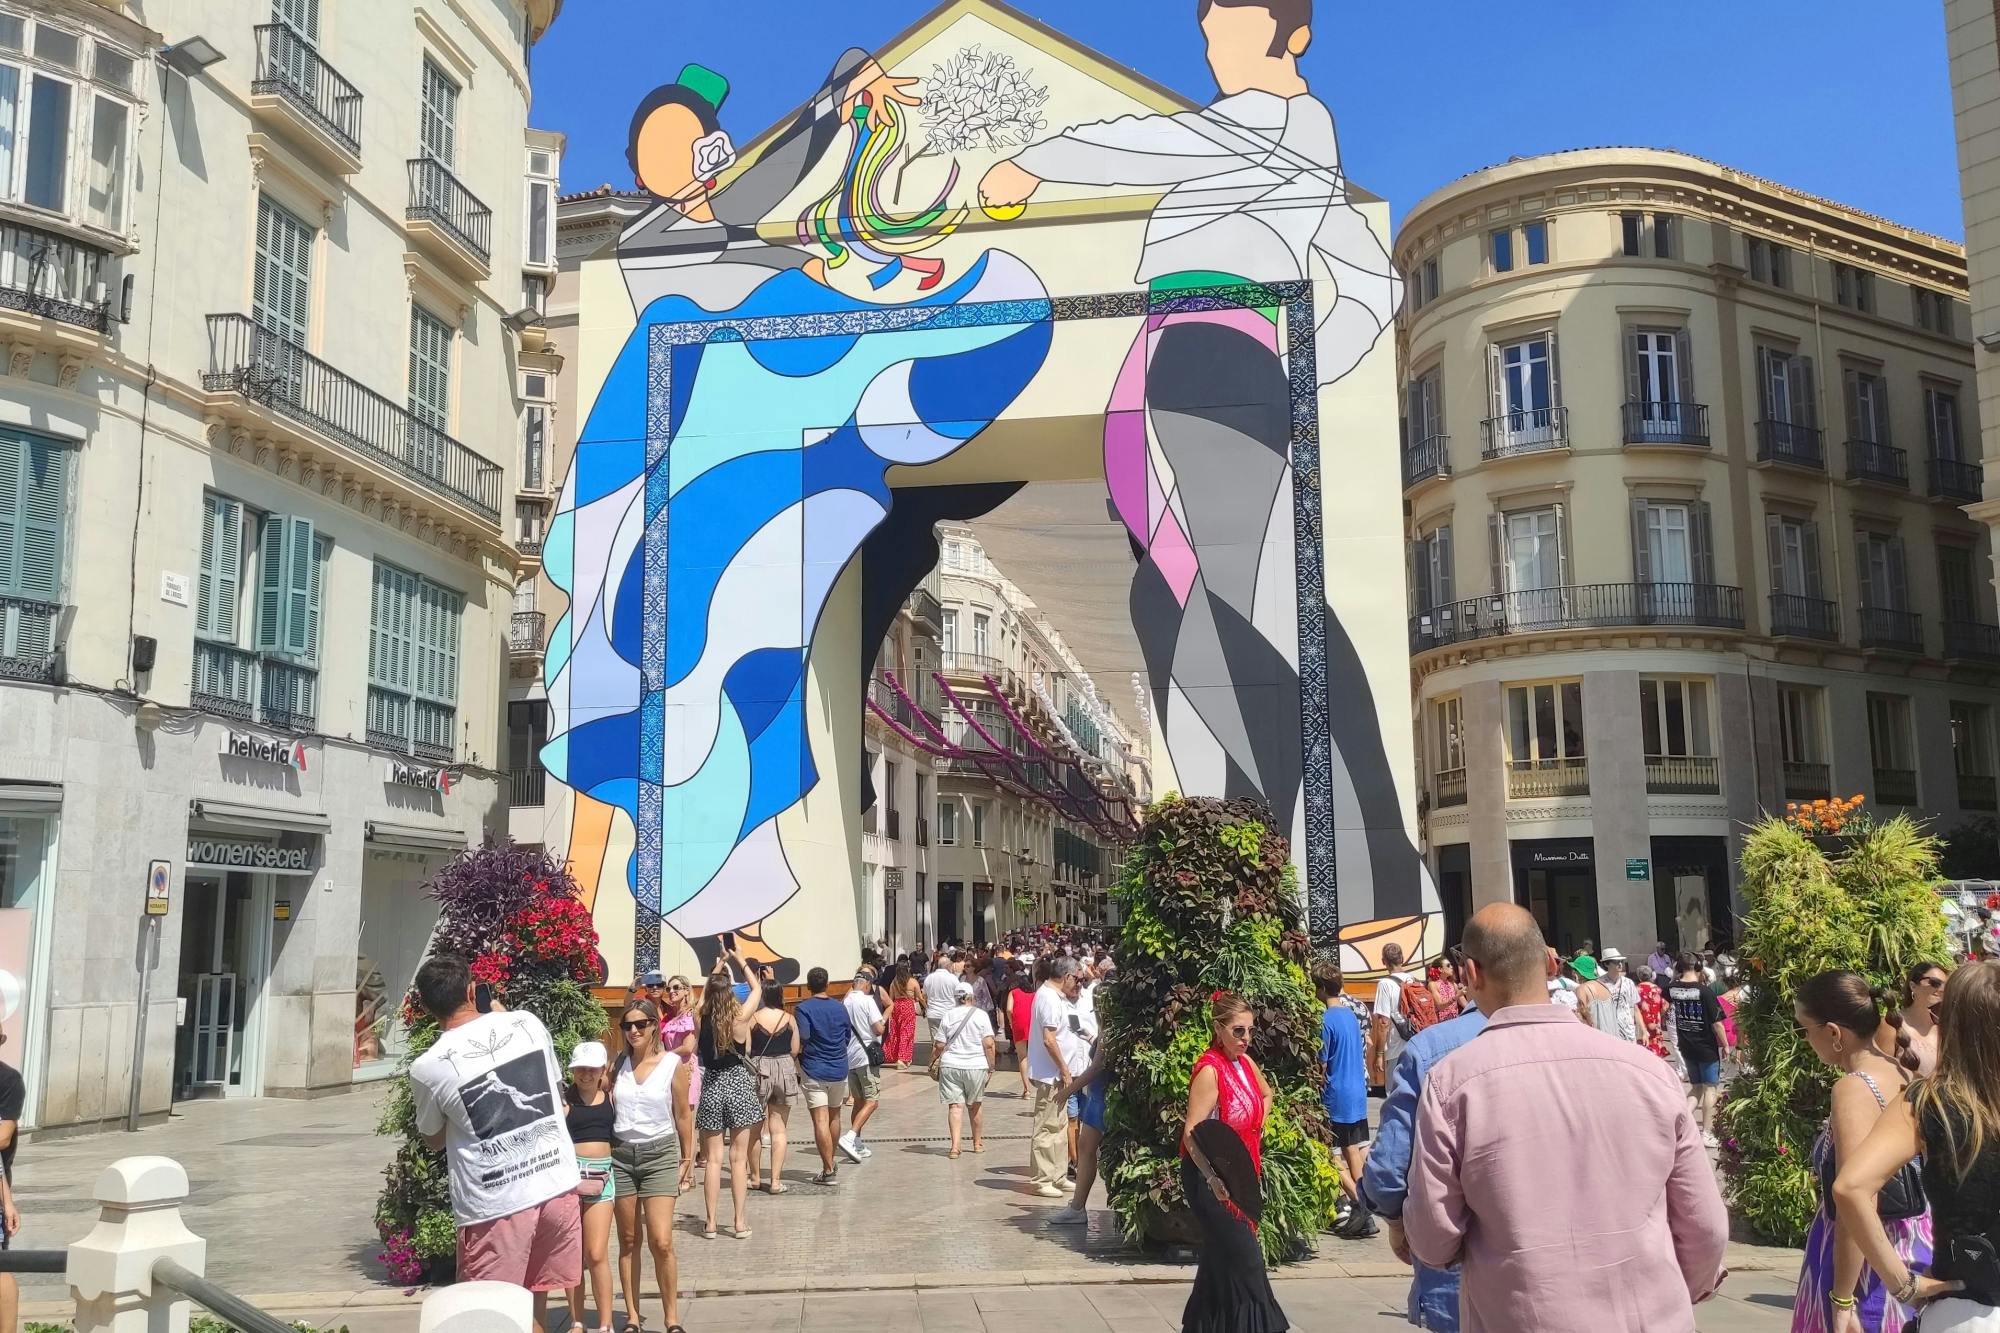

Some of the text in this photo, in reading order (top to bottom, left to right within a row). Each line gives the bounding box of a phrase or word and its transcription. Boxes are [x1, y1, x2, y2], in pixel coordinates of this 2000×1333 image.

[228, 731, 290, 764] helvetia
[392, 763, 437, 789] helvetia
[188, 841, 308, 869] women'secret
[504, 1164, 519, 1174] look
[538, 1149, 552, 1161] seed
[484, 1177, 510, 1188] success
[511, 1172, 518, 1182] in
[519, 1168, 534, 1179] every
